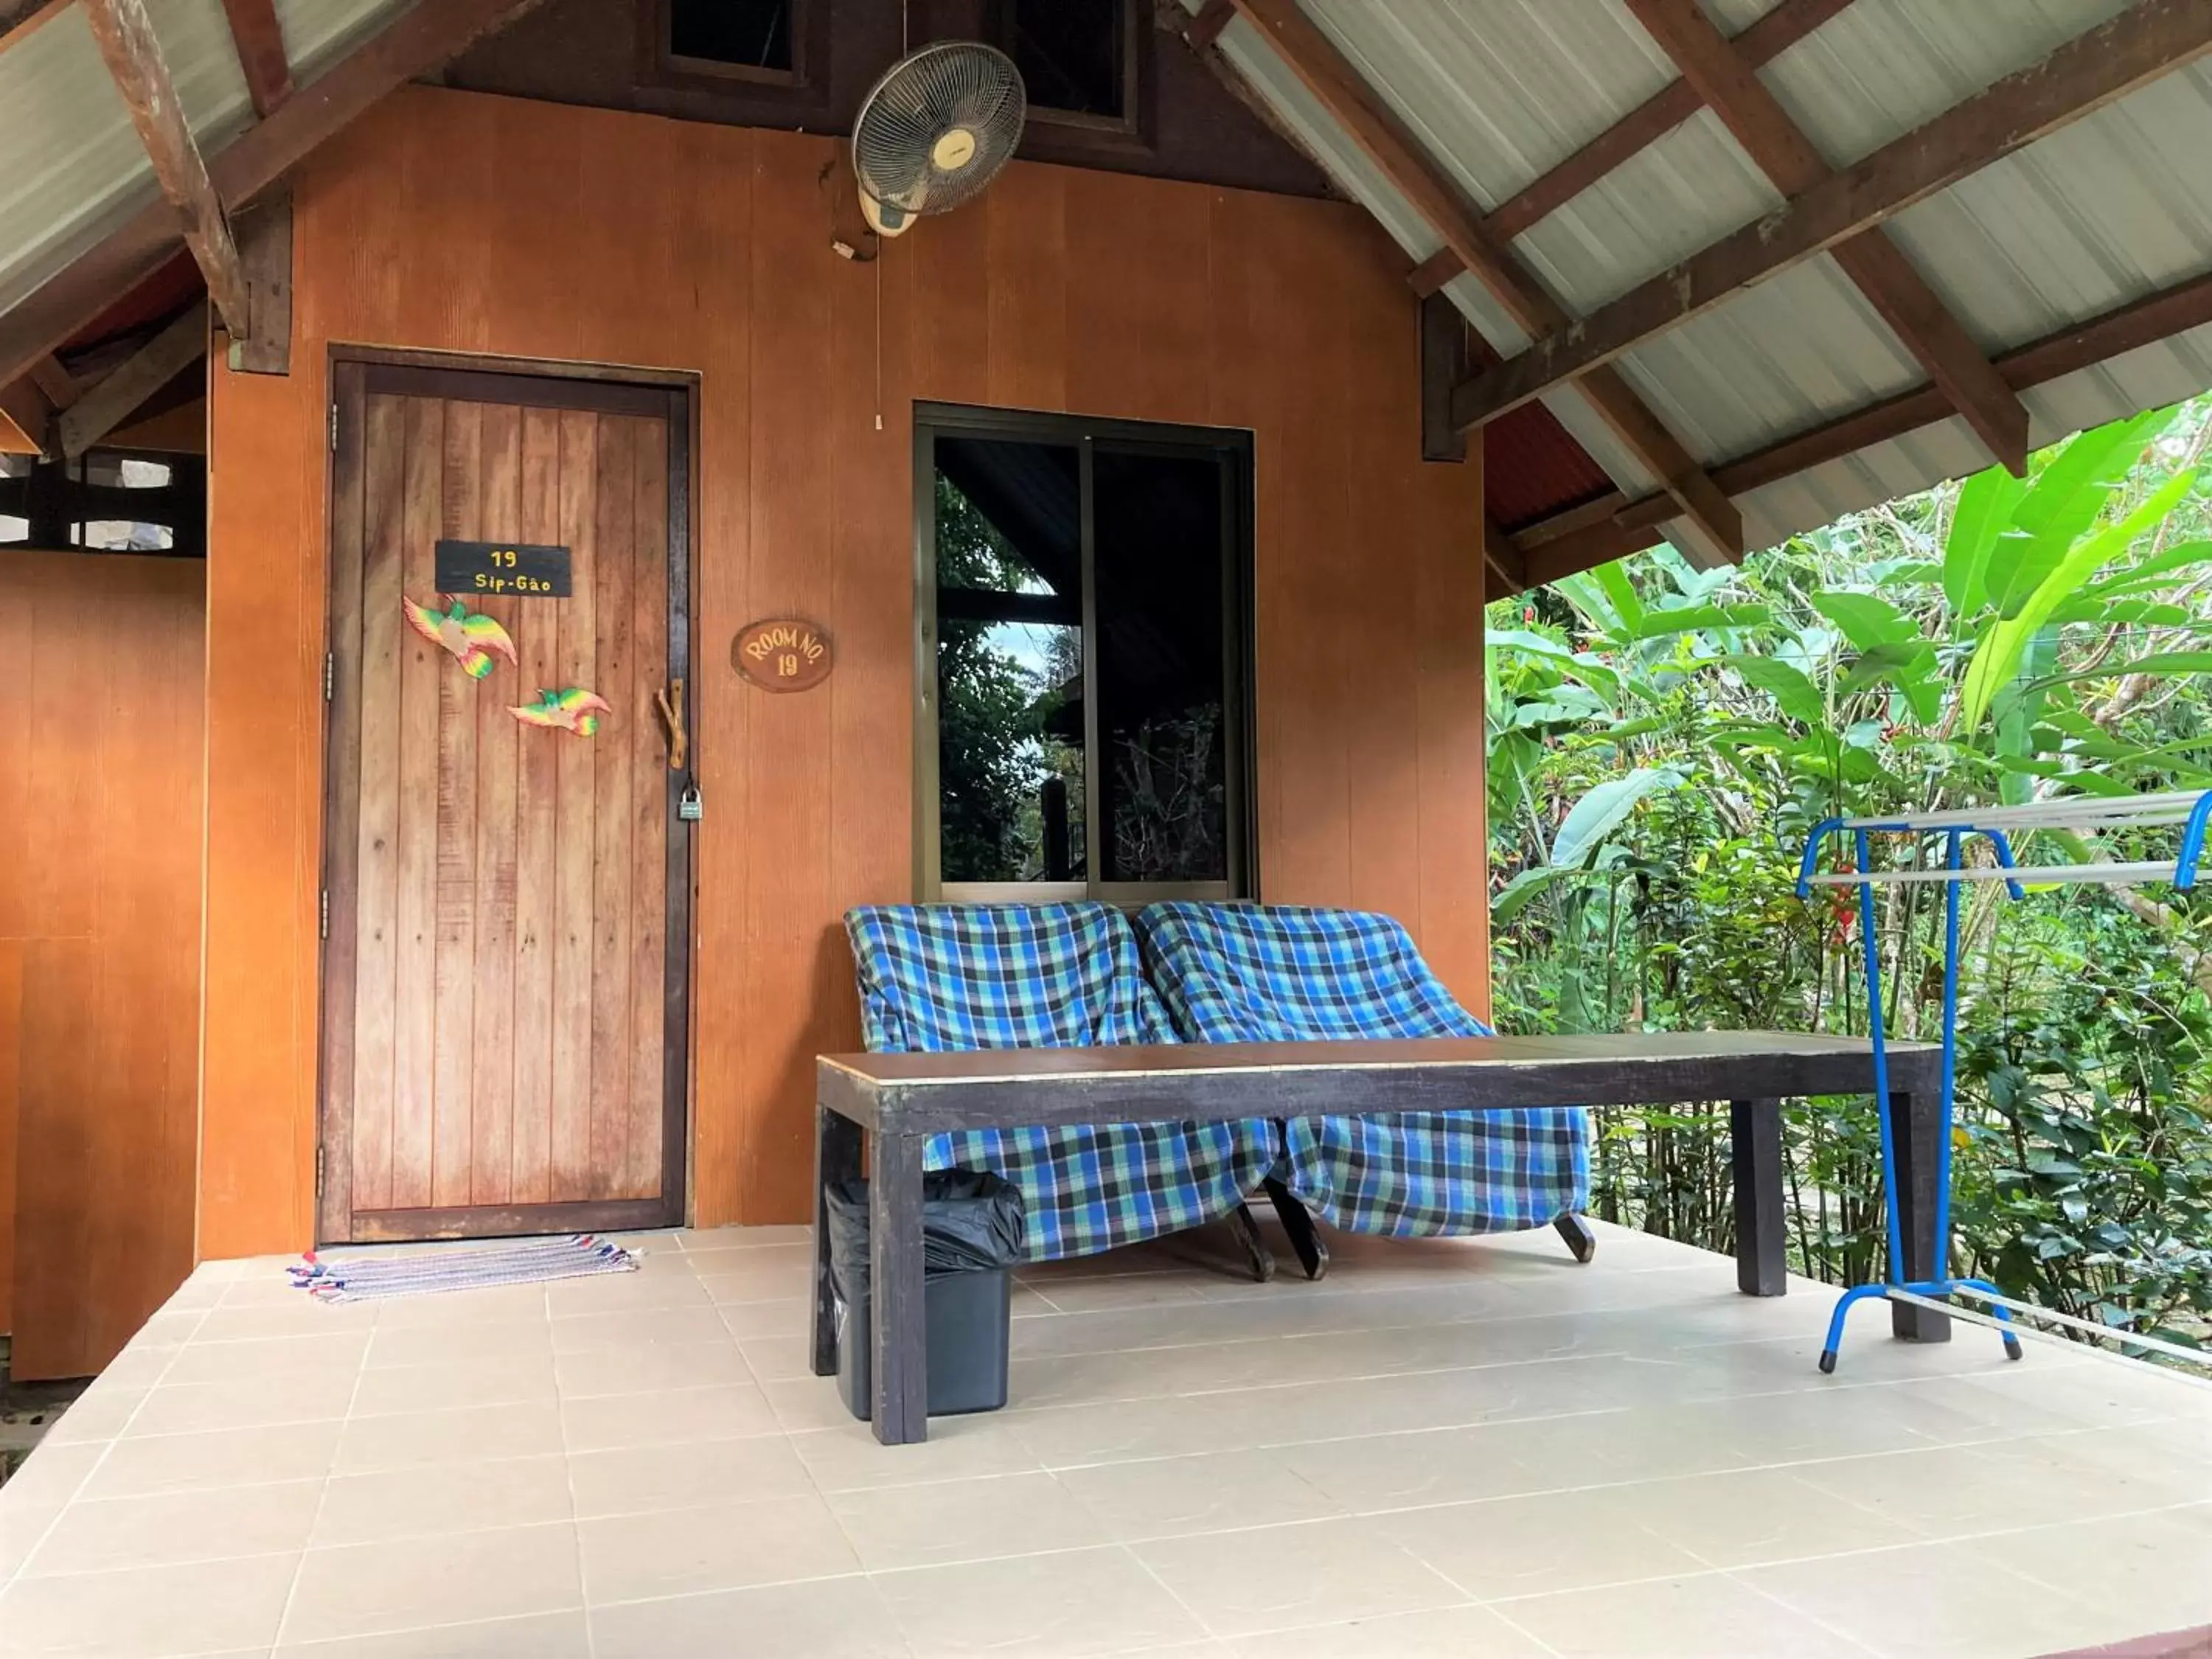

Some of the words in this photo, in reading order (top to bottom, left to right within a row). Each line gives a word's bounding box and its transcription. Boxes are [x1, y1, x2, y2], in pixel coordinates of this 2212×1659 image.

[490, 551, 517, 567] 19
[745, 627, 798, 661] ROOM
[778, 653, 798, 676] 19
